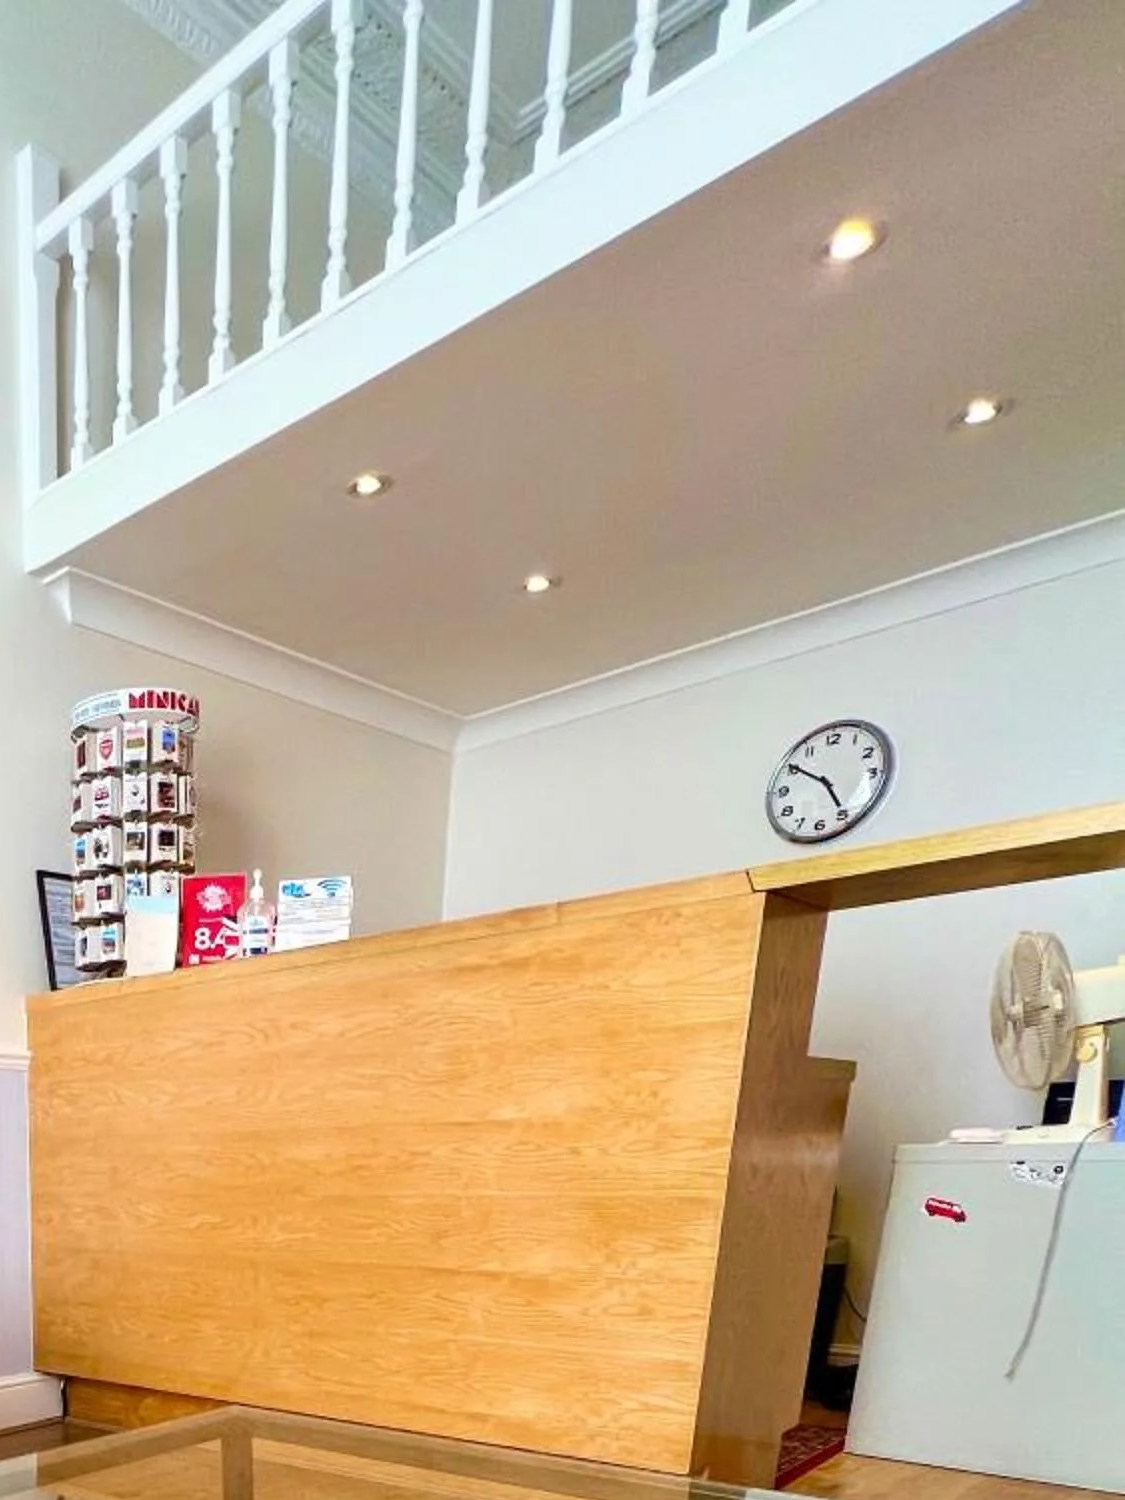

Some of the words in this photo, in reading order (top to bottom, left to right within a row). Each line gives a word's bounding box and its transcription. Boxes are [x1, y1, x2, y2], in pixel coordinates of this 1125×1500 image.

[826, 733, 842, 745] 12
[805, 746, 814, 758] 11
[862, 747, 874, 759] 2
[867, 768, 878, 779] 3
[778, 785, 790, 798] 9
[780, 805, 794, 817] 8
[836, 809, 848, 821] 5
[794, 817, 806, 829] 7
[814, 819, 826, 831] 6
